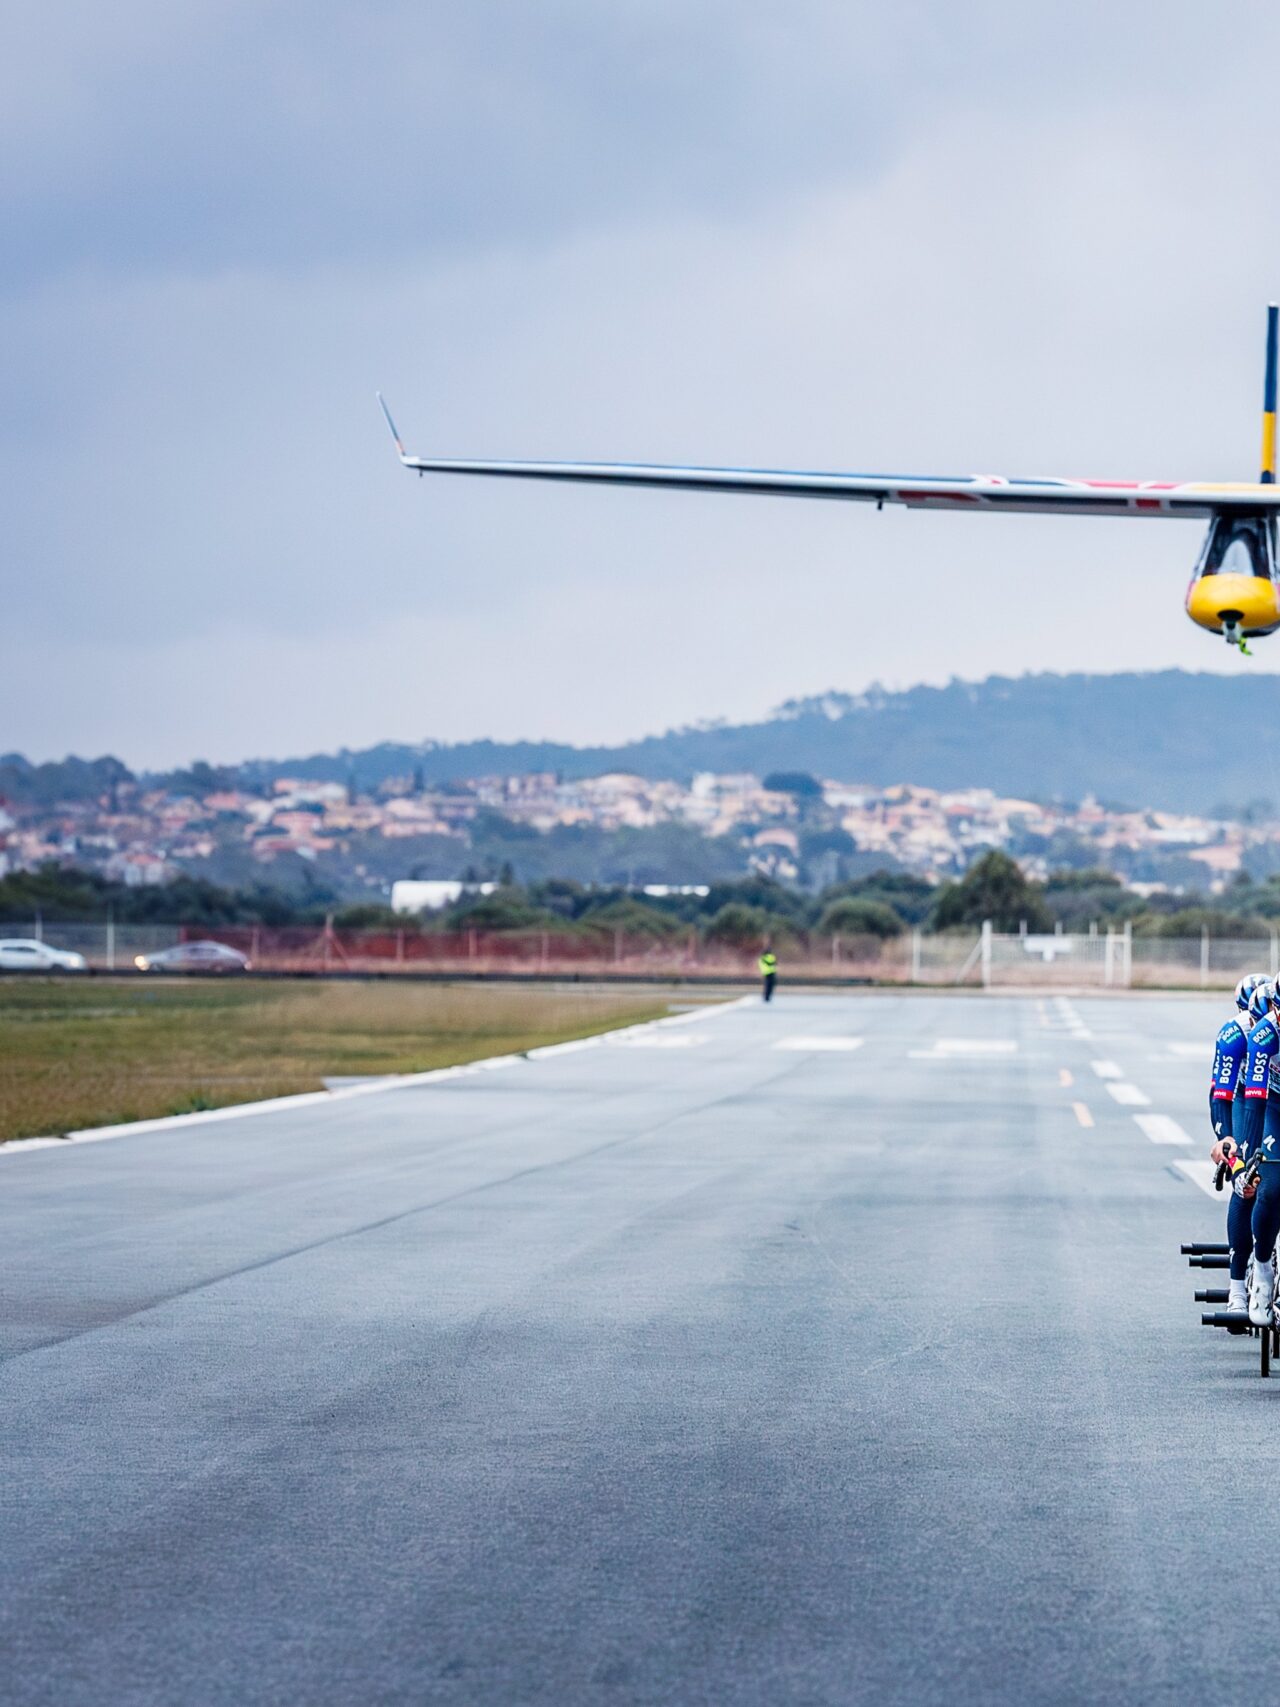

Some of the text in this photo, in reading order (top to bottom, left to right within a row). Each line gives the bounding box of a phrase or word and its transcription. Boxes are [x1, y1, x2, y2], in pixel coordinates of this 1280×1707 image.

[1222, 1025, 1240, 1041] BORA
[1252, 1026, 1271, 1043] BORA
[1219, 1055, 1234, 1084] BOSS
[1252, 1051, 1268, 1082] BOSS
